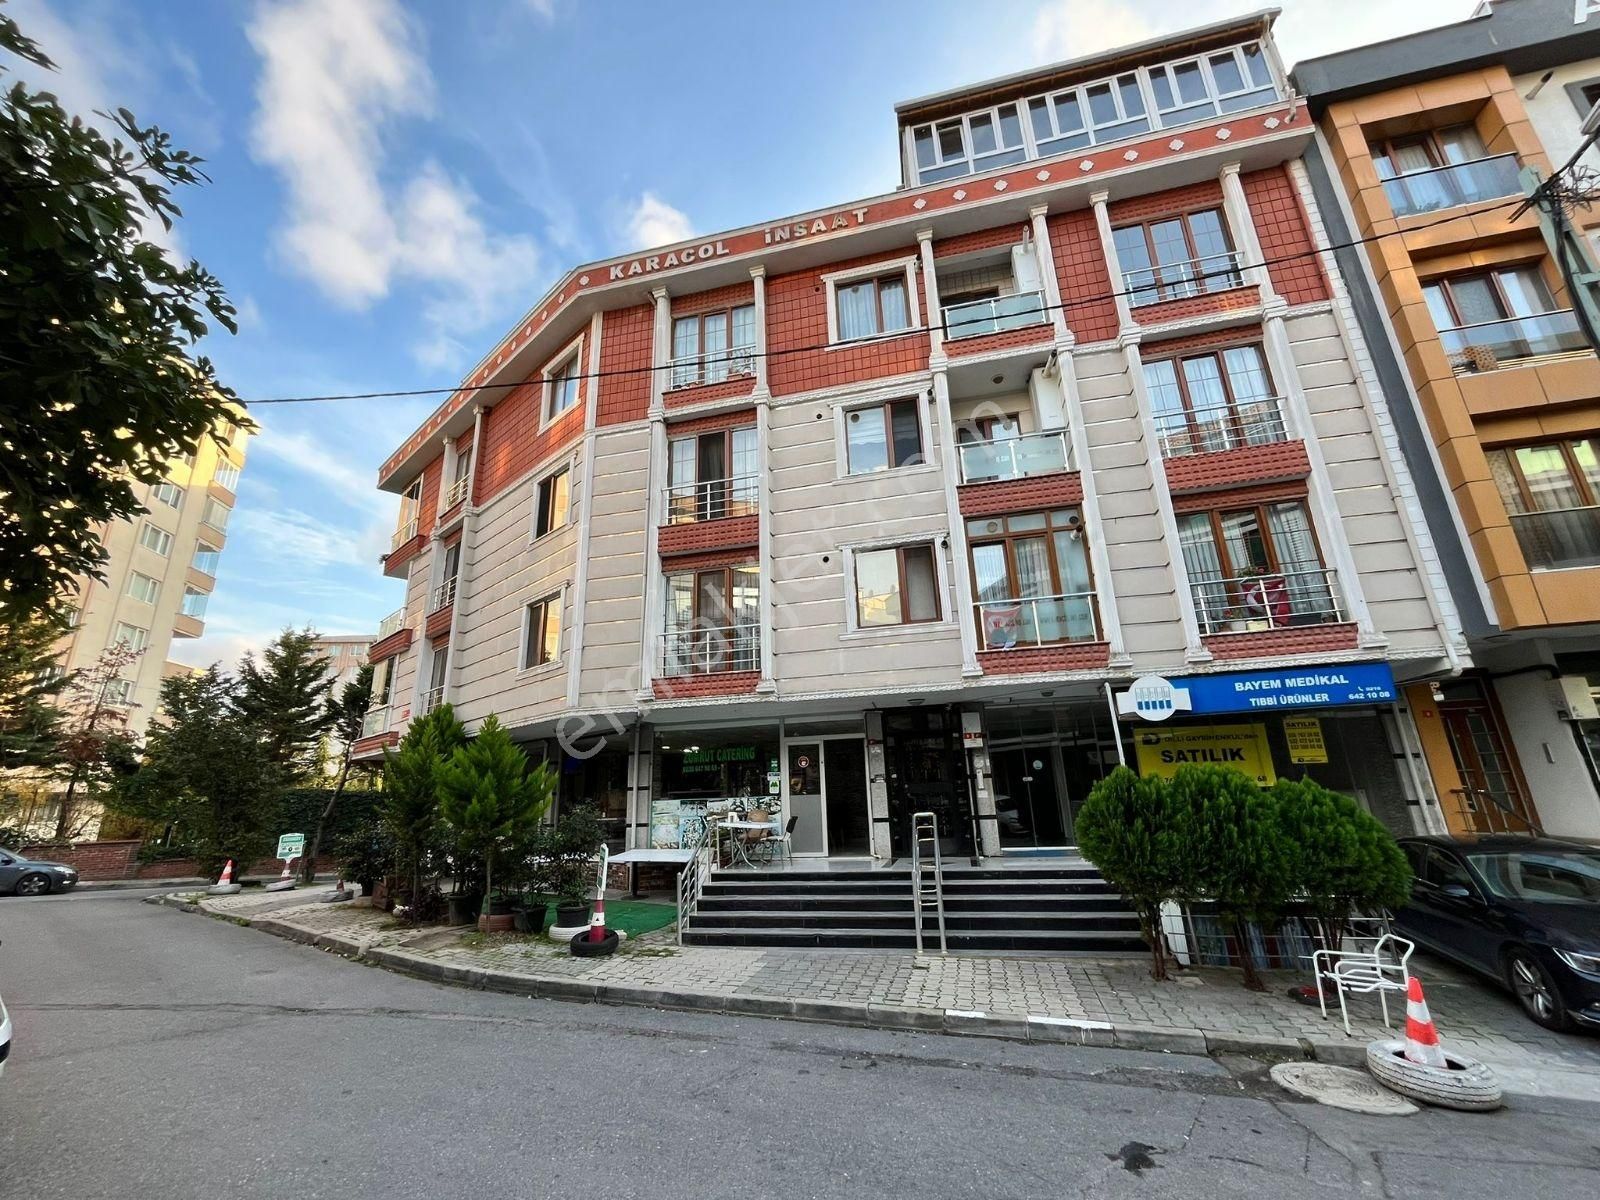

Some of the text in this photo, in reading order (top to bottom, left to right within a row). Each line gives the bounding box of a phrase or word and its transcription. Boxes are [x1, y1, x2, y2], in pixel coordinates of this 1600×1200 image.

[609, 241, 730, 281] KARACOL
[1234, 674, 1349, 692] BAYEM MEDİKAL
[1249, 693, 1330, 706] TIBBİ ÜRÜNLER
[1161, 747, 1246, 763] SATILIK
